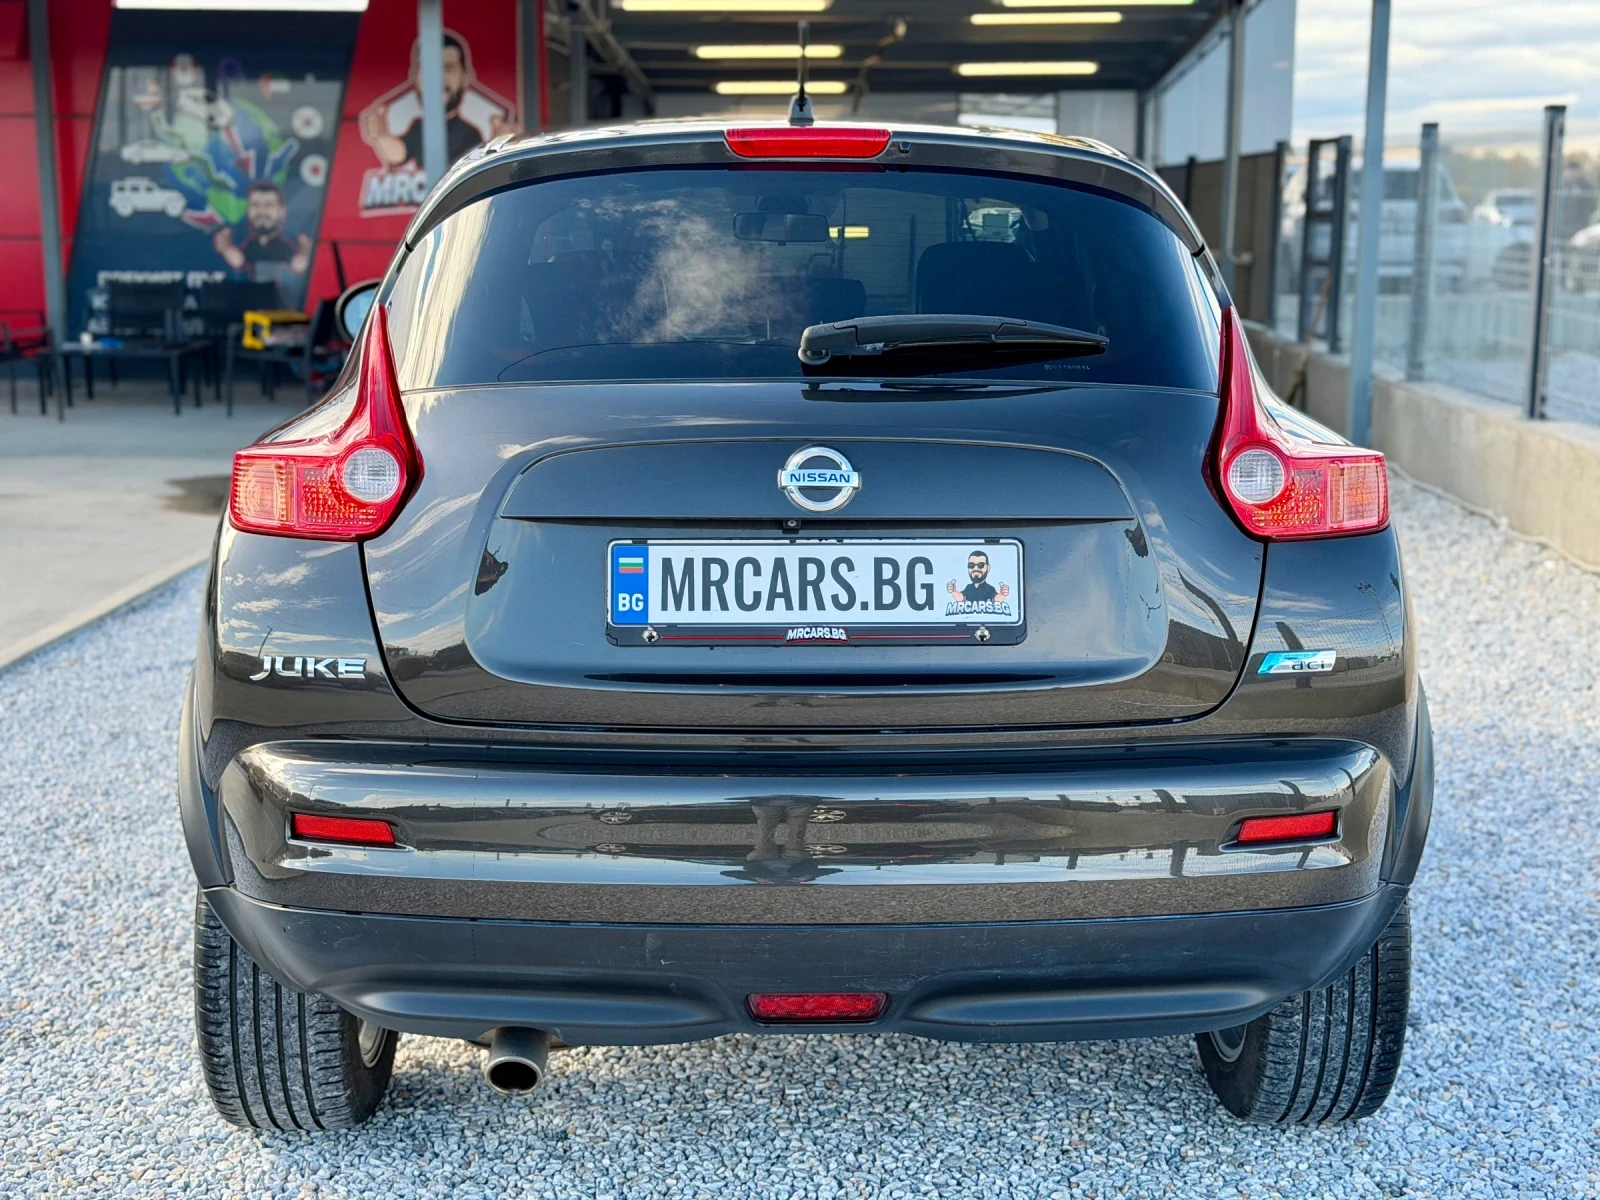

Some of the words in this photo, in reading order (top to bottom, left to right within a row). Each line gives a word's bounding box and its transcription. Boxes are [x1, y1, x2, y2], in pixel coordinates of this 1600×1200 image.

[365, 171, 428, 207] MRC
[790, 473, 850, 483] NISSAN
[661, 556, 934, 612] MRCARS.BG
[617, 593, 644, 612] BG
[945, 600, 1012, 616] MRCARS.BG
[786, 627, 847, 641] MRCARS.BG
[249, 656, 368, 681] JUKE
